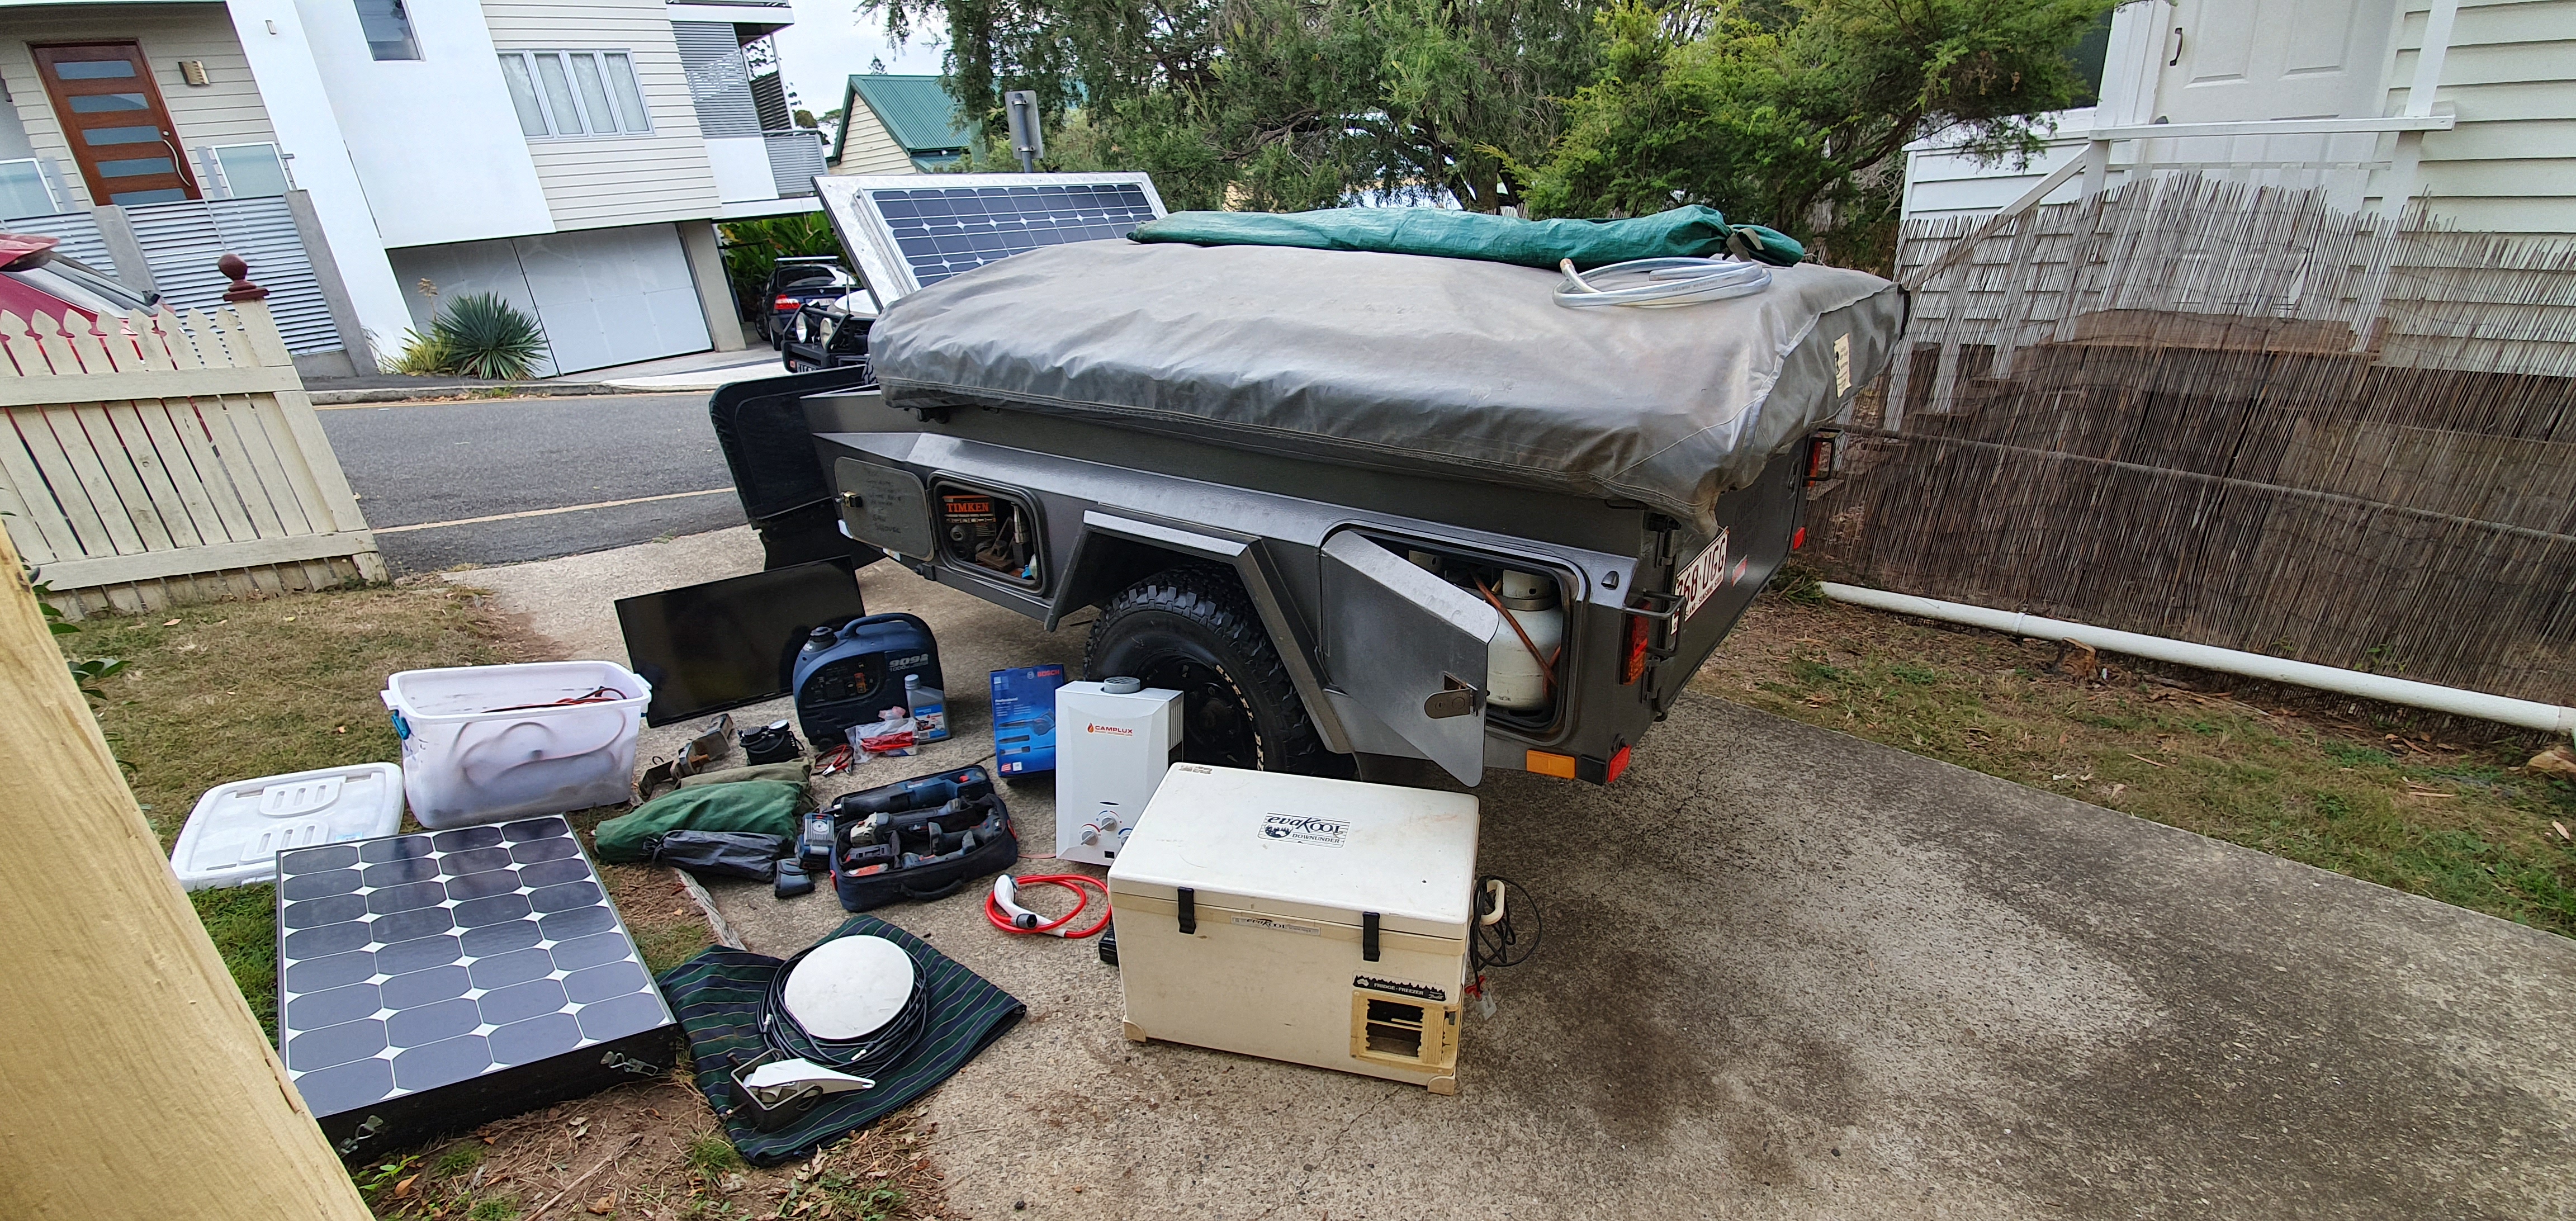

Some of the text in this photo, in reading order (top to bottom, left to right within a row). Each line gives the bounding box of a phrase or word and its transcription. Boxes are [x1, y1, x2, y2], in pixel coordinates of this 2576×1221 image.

[946, 502, 989, 513] TIMKEN
[1037, 669, 1060, 678] BOSCH
[1215, 664, 1254, 722] STEEL
[1095, 725, 1133, 734] CAMPLUX
[1292, 833, 1339, 843] DOWNUNDER
